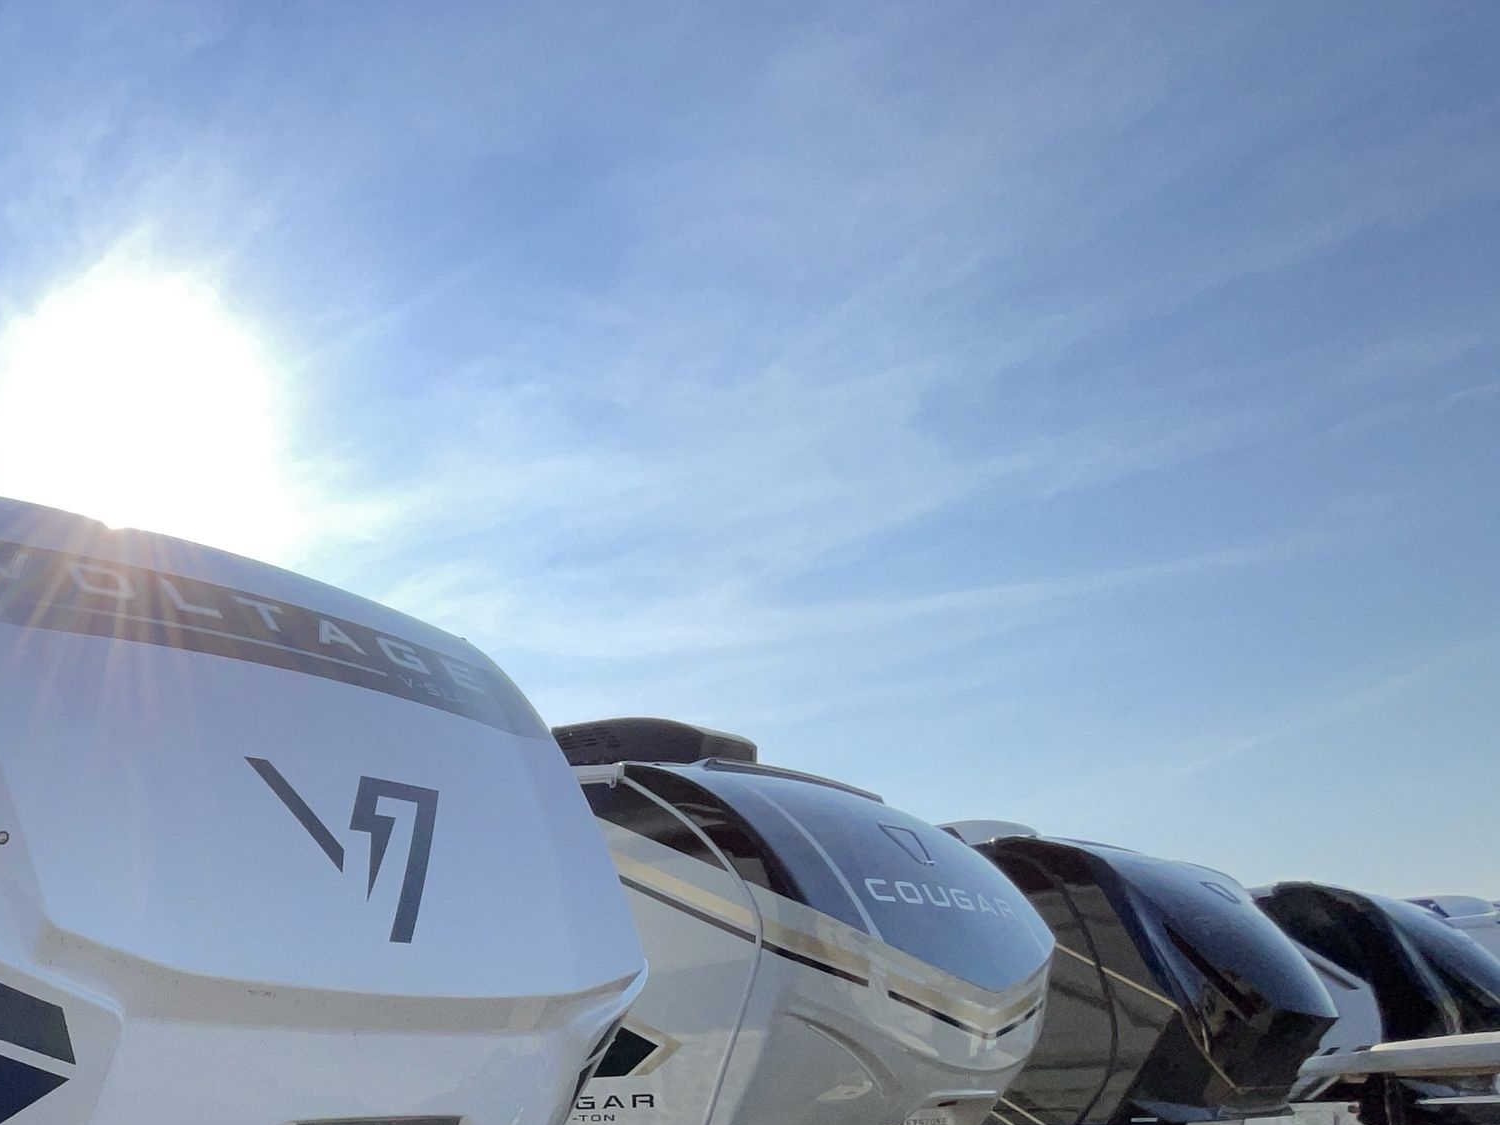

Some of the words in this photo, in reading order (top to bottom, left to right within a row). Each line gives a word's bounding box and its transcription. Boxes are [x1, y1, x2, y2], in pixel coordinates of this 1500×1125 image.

[864, 878, 1018, 920] COUGAR
[575, 1094, 655, 1110] GAR
[572, 1114, 615, 1122] -TON
